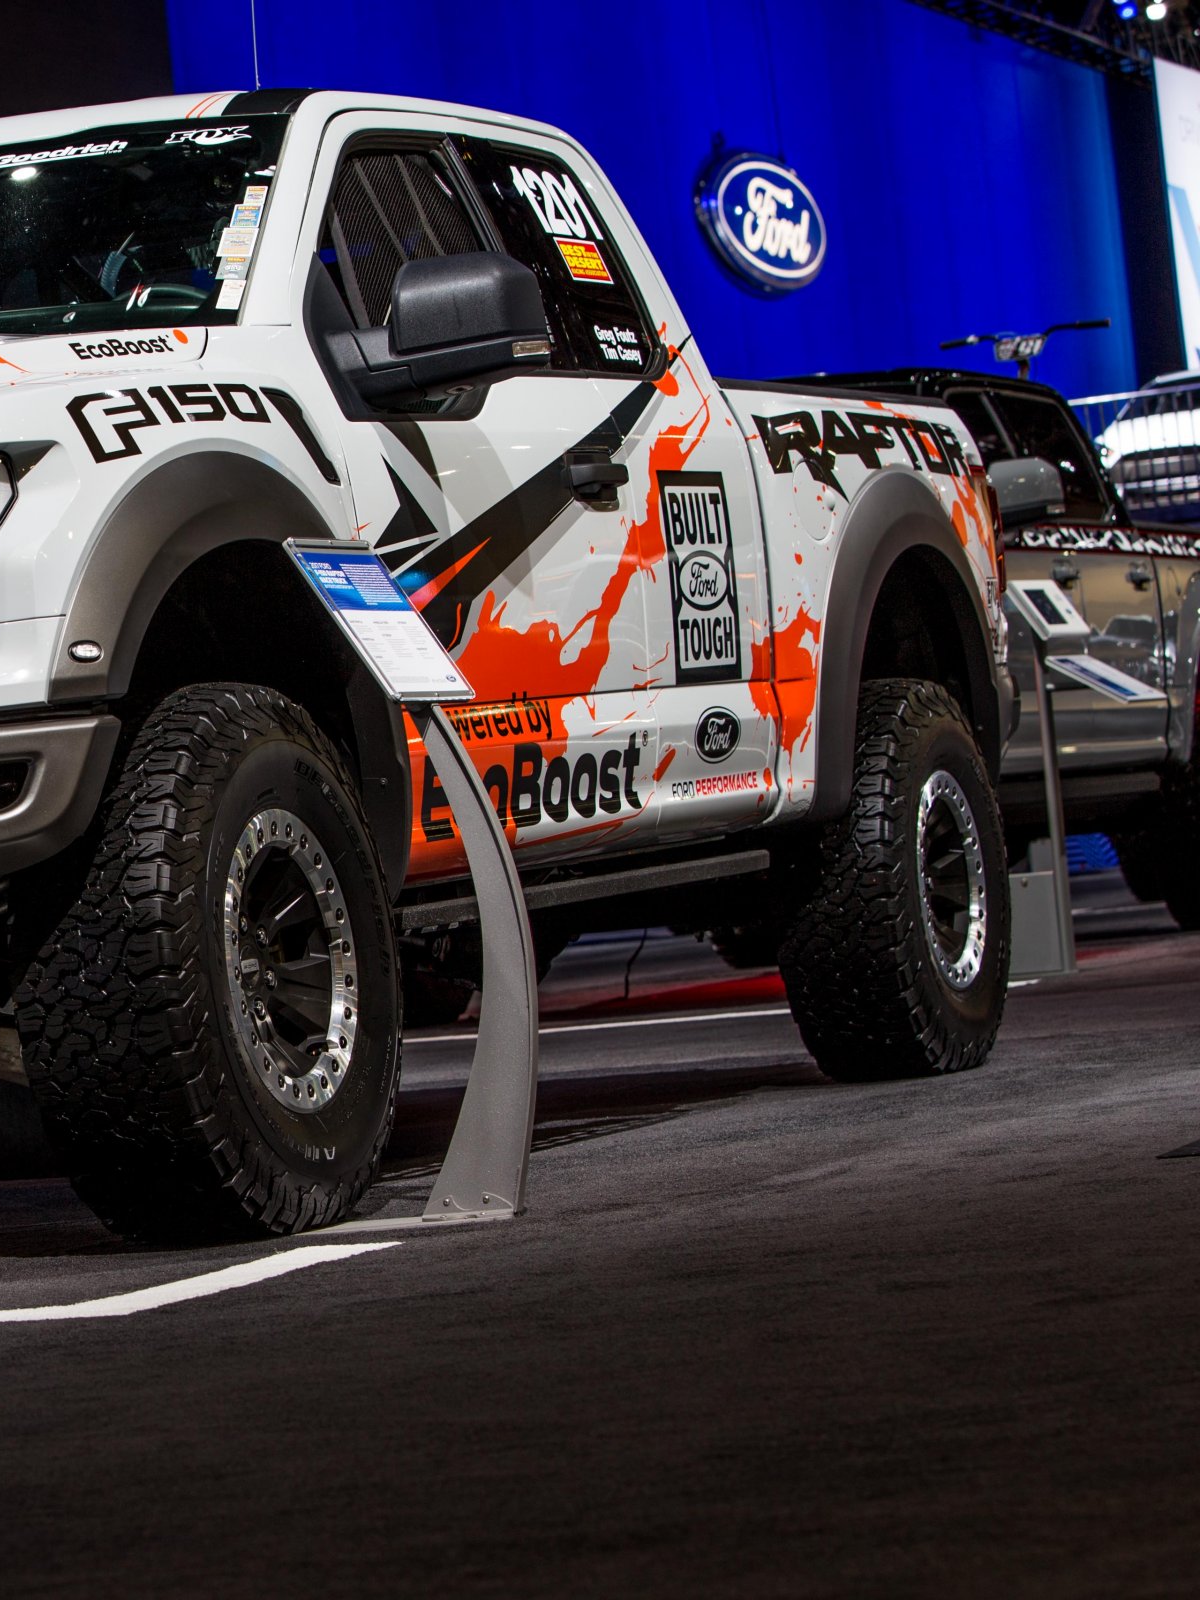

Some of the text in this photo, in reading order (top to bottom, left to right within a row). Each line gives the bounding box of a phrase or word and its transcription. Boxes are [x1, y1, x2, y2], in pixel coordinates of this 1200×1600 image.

[164, 125, 252, 145] FOX
[509, 165, 604, 240] 1201
[743, 176, 811, 264] Ford
[559, 243, 587, 258] BEST
[565, 255, 604, 271] DESERT
[68, 334, 175, 360] EcoBoost
[593, 324, 617, 345] Greg
[599, 343, 642, 365] Tim Casey
[751, 410, 975, 504] RAPTOR
[667, 492, 723, 545] BUILT
[689, 561, 719, 598] Ford
[680, 616, 734, 663] TOUGH
[447, 692, 553, 742] wered by
[704, 717, 732, 751] Ford
[421, 732, 643, 843] EoBoost
[671, 771, 759, 799] FORD PERFORMANCE
